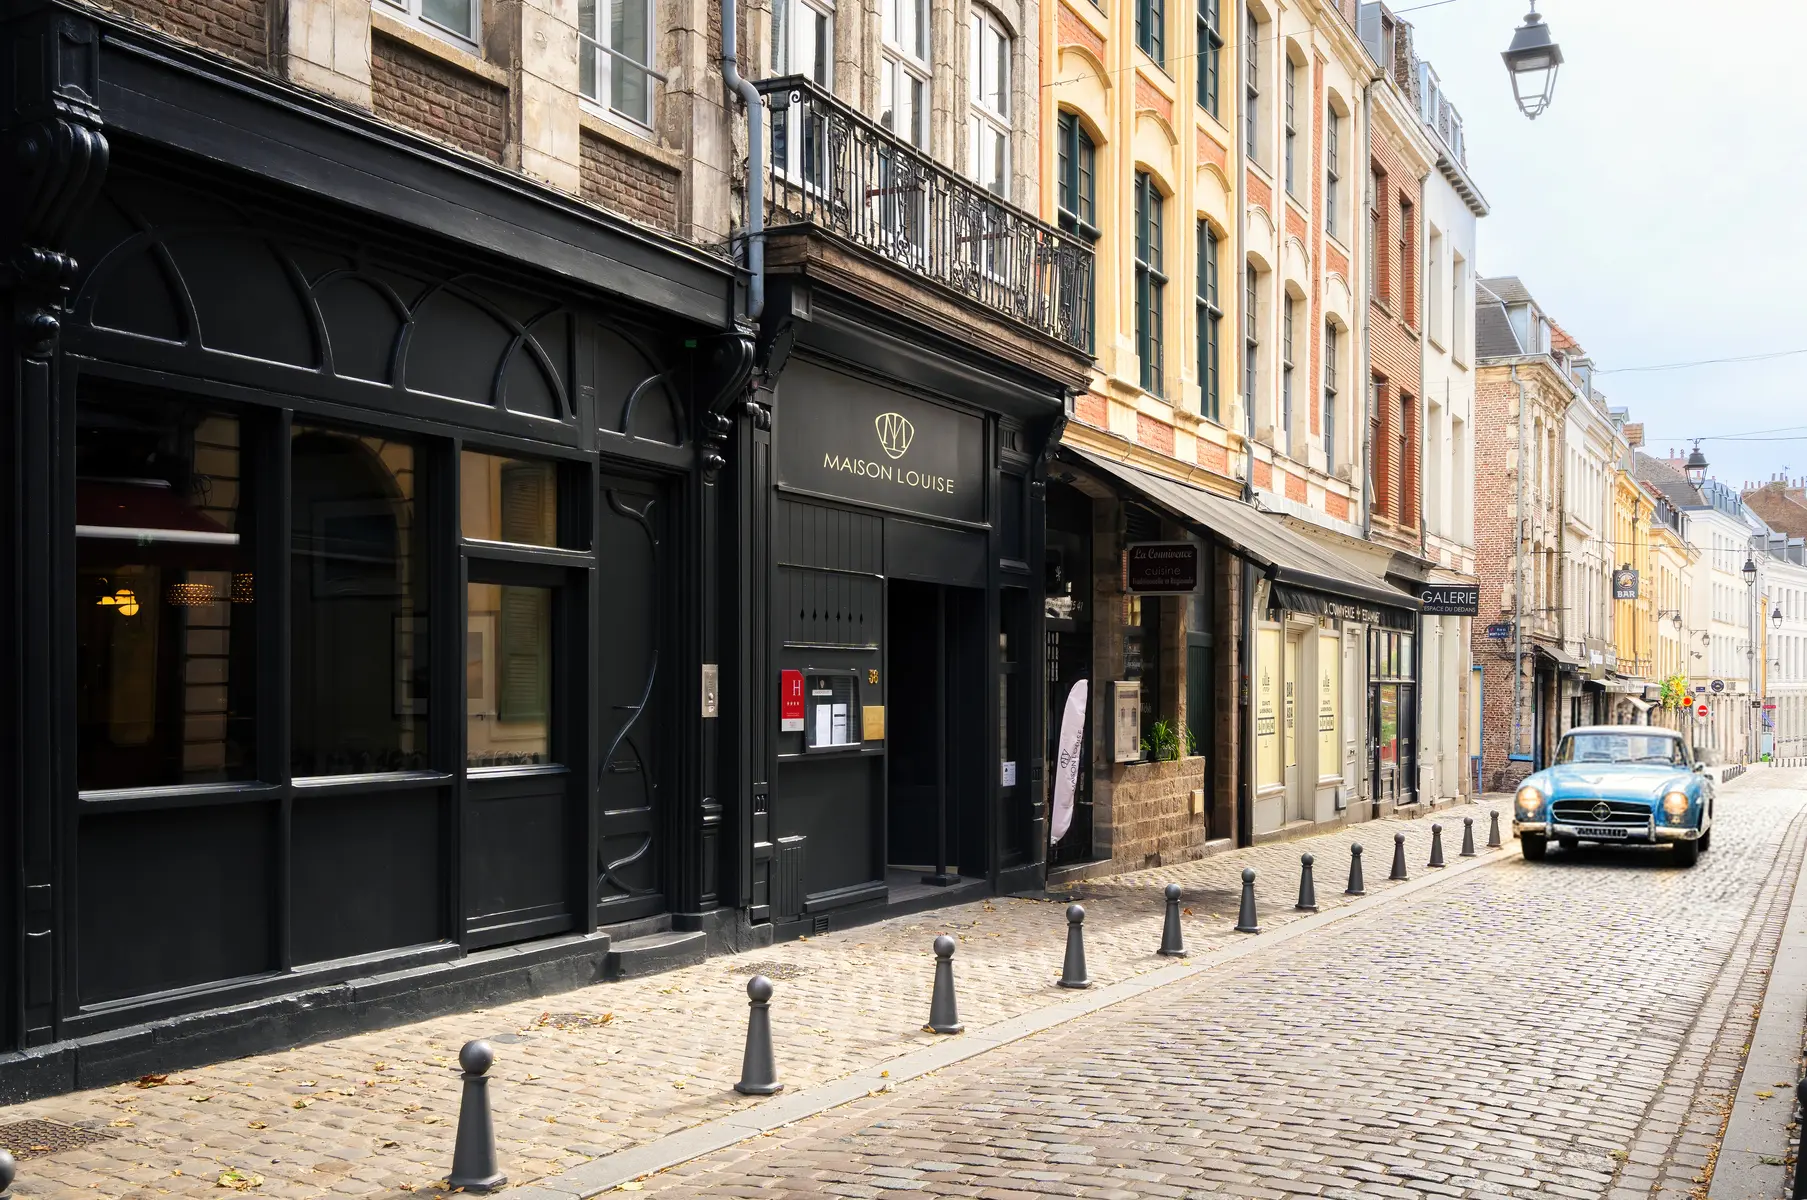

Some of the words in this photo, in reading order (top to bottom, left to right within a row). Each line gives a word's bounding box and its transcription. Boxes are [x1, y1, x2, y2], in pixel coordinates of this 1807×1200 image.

[824, 453, 892, 481] MAISON
[897, 468, 954, 494] LOUISE
[1134, 548, 1146, 559] La
[1148, 548, 1192, 559] Connivence
[1145, 566, 1181, 576] cuisine
[1421, 590, 1477, 604] GALERIE
[1617, 590, 1635, 598] BAR
[793, 680, 801, 696] H
